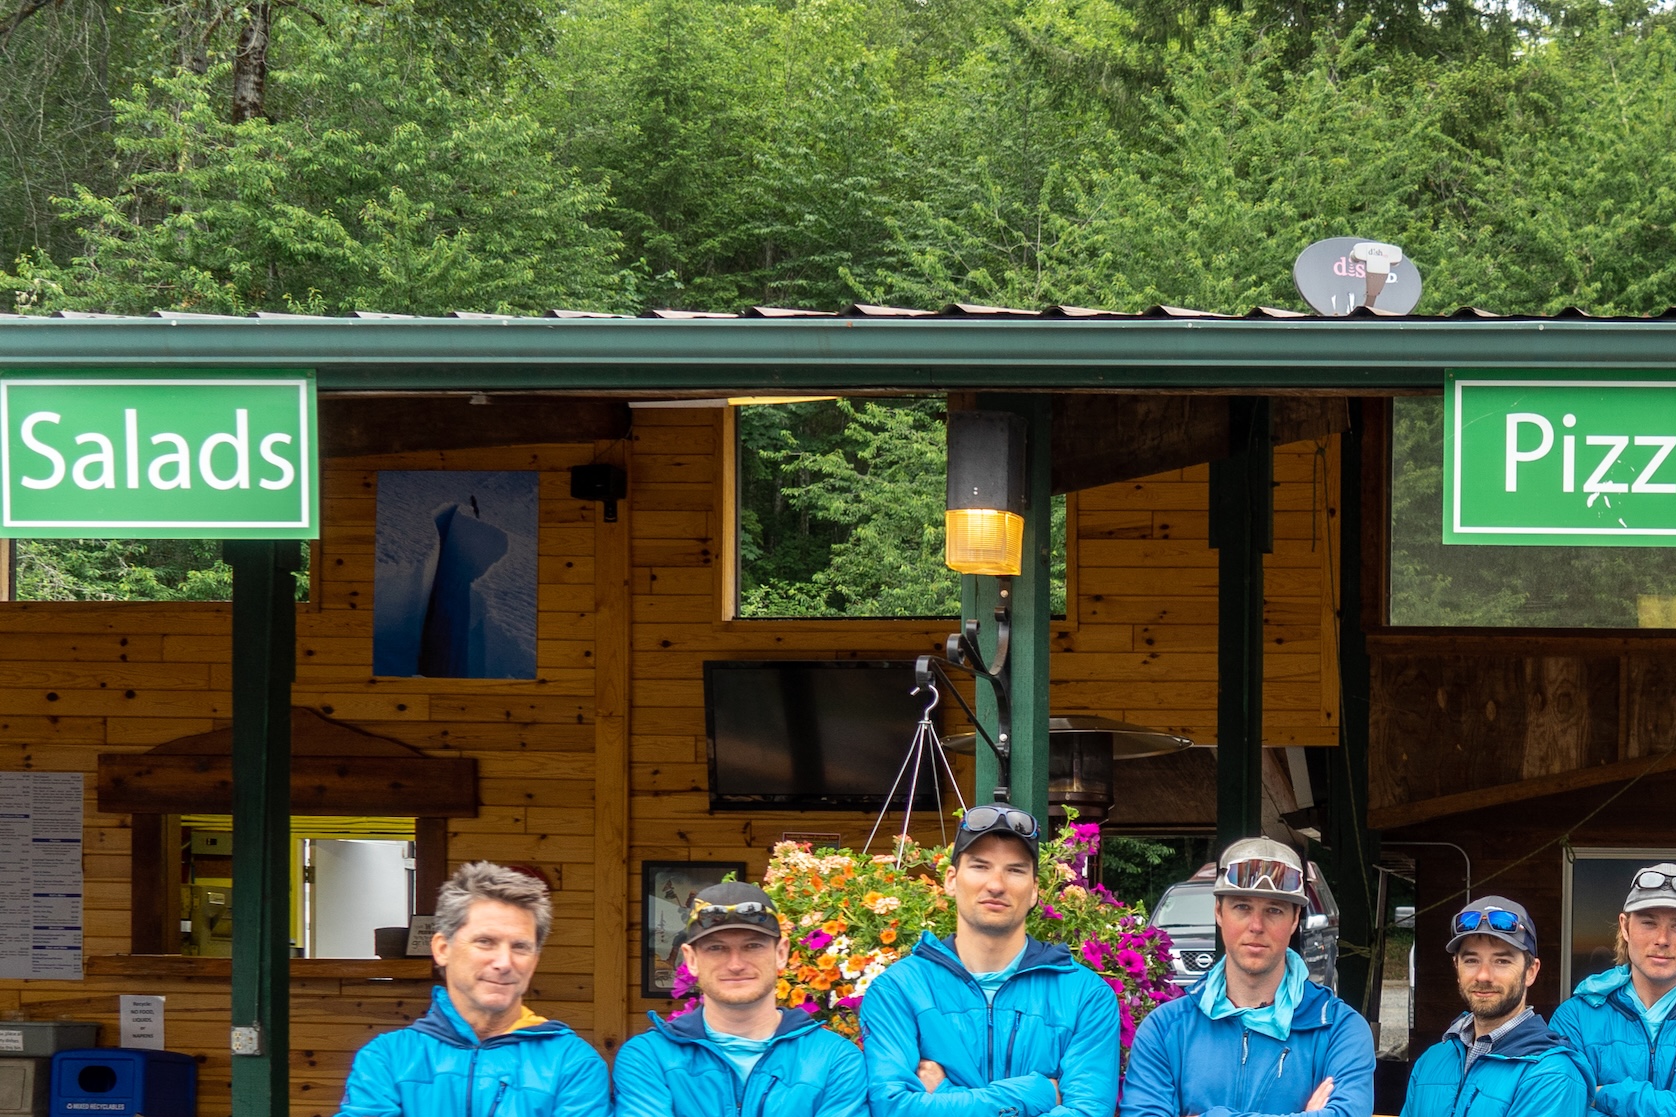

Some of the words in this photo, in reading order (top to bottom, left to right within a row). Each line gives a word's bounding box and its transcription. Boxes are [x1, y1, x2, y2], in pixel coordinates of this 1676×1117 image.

[1333, 256, 1367, 279] dis
[20, 408, 296, 491] Salads
[90, 1103, 125, 1111] RECYCLABLES
